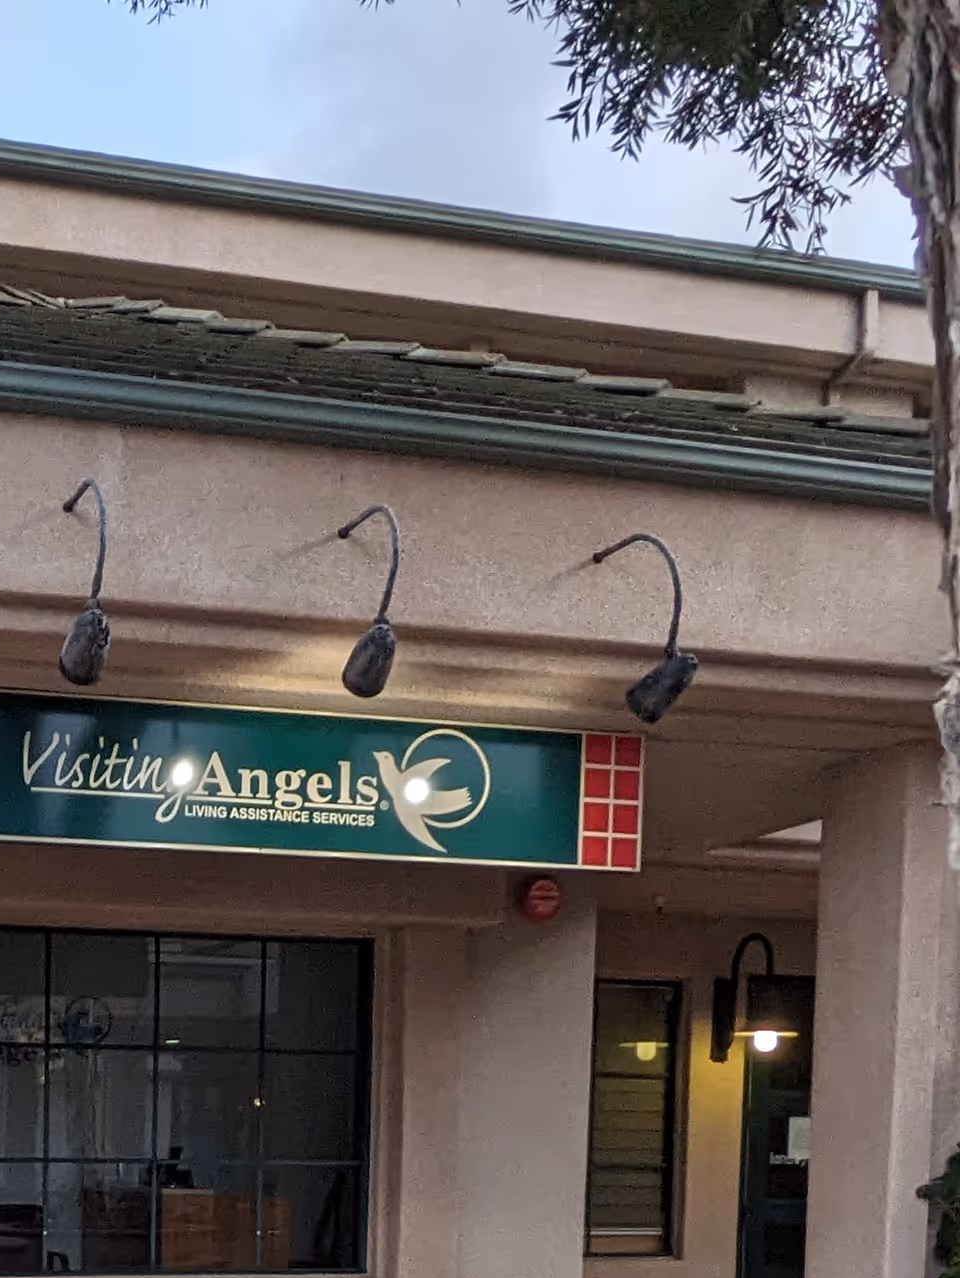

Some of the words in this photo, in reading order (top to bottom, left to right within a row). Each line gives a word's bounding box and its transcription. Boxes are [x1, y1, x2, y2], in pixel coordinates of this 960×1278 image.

[21, 729, 194, 823] Visiting
[196, 750, 380, 809] Angels
[184, 803, 227, 820] LIVING
[229, 806, 310, 824] ASSISTANCE
[312, 810, 376, 828] SERVICES
